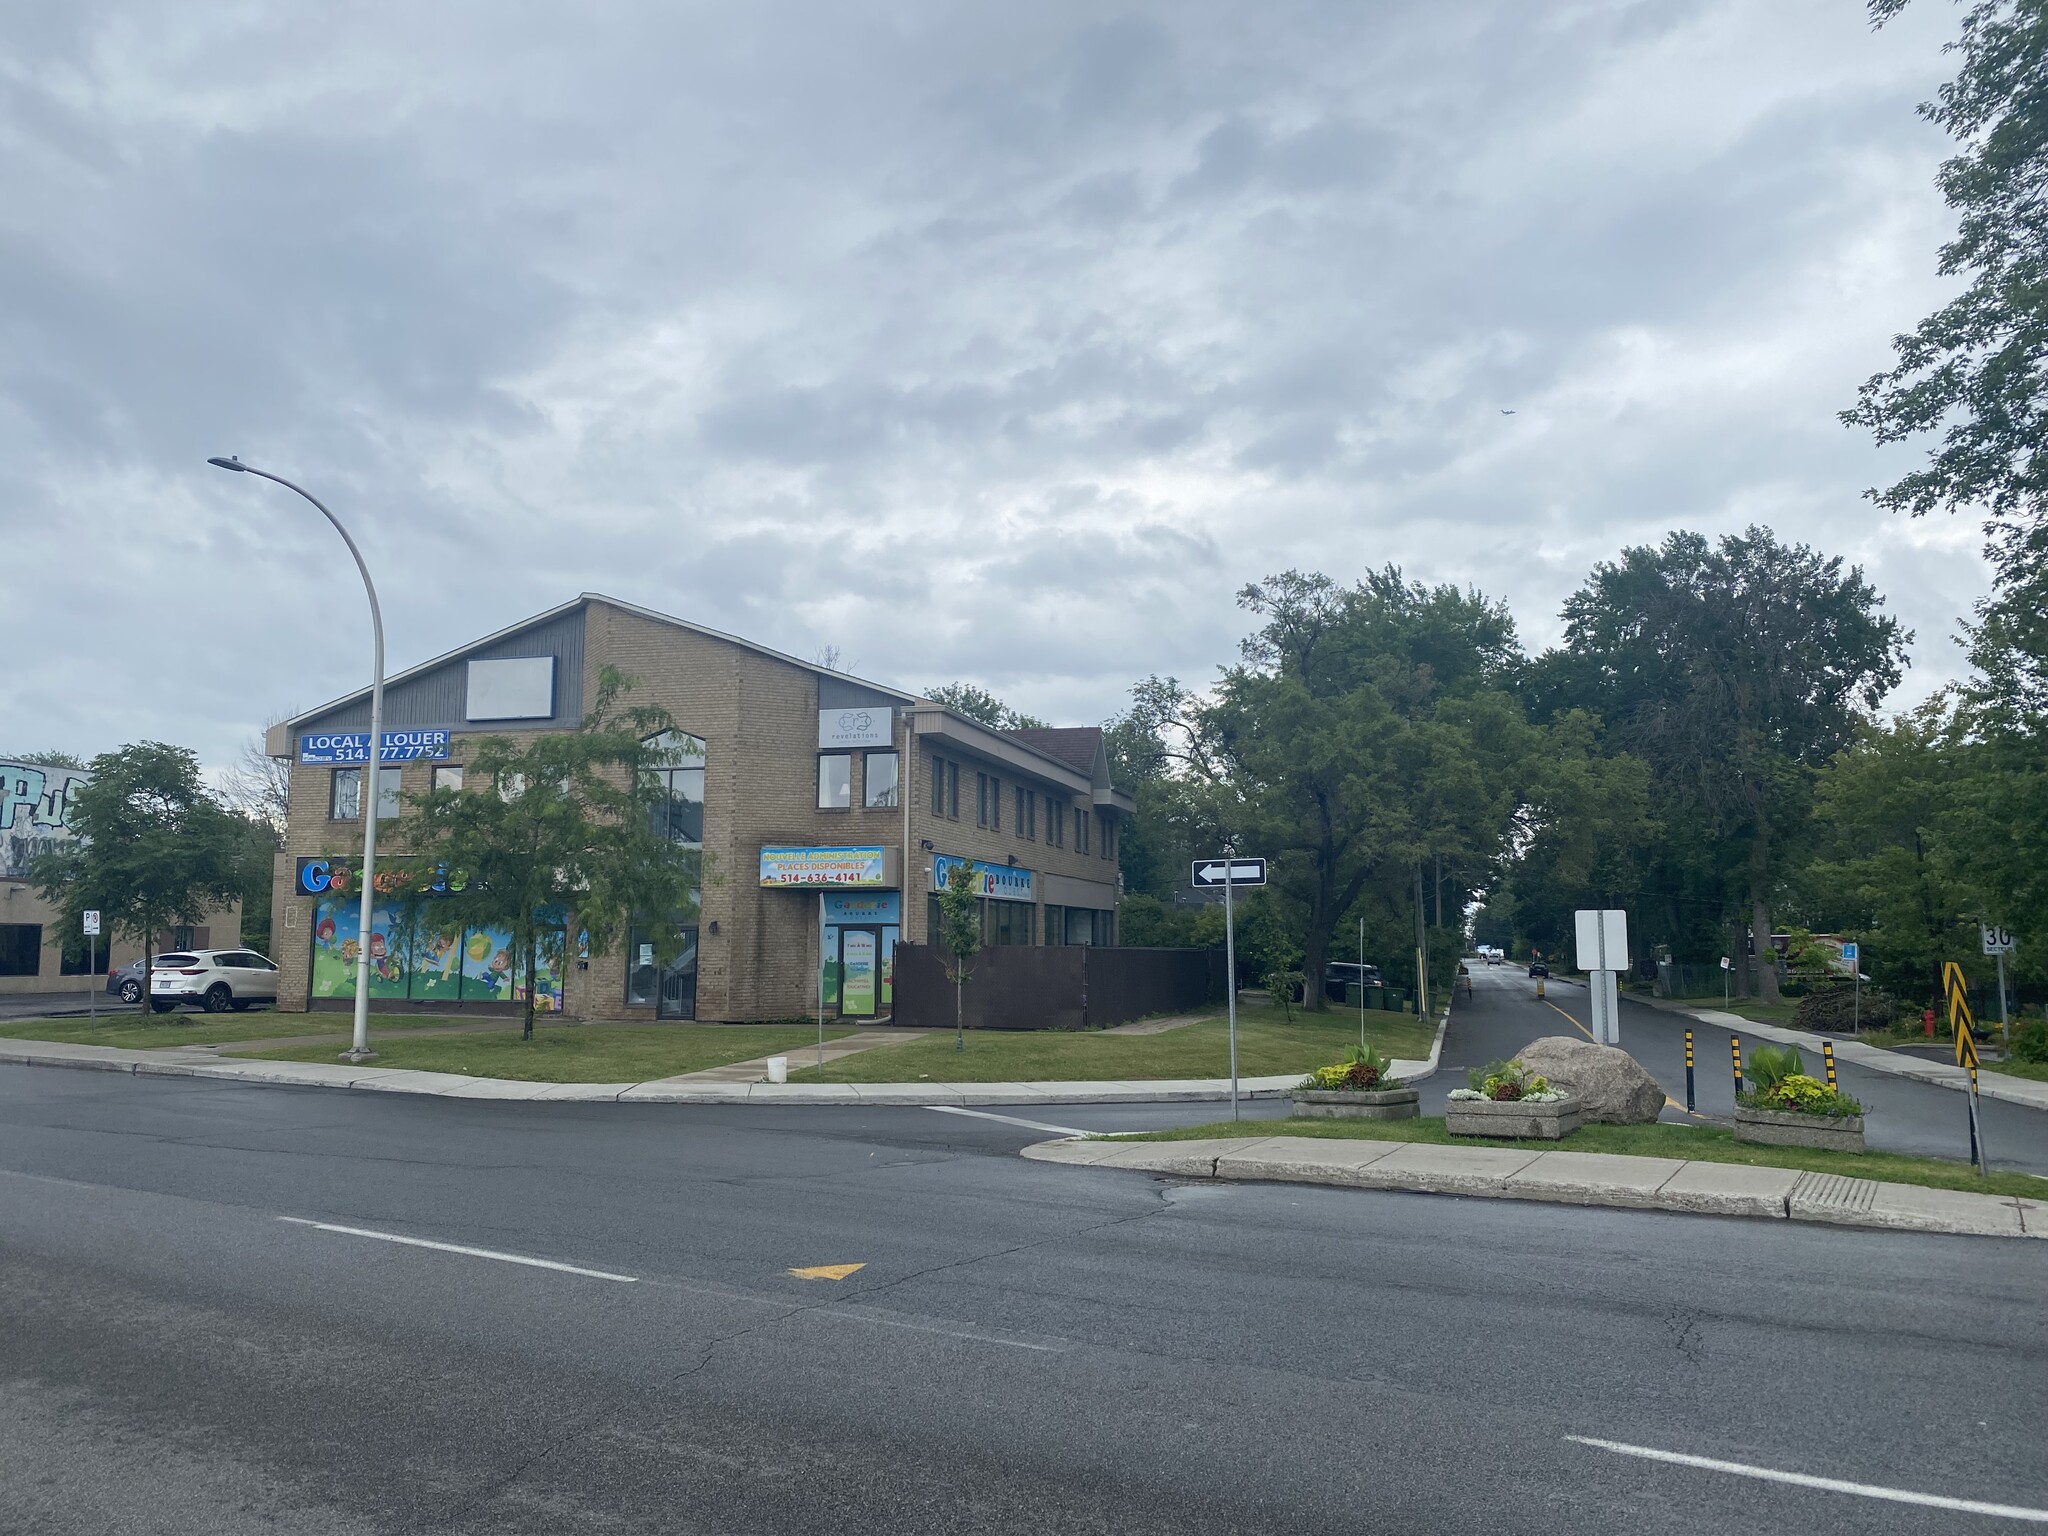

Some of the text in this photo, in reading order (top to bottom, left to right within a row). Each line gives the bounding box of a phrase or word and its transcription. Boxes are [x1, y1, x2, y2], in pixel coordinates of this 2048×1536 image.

[308, 732, 446, 749] LOCAL LOUER
[831, 732, 879, 740] revelations
[335, 745, 445, 761] 514.77.7752
[763, 851, 880, 861] NOUVELLE ADMINISTRATION
[777, 862, 865, 871] PLACES DISPONIBLES
[780, 872, 861, 883] 514-636-4141
[995, 873, 1031, 889] BOURKE
[1986, 928, 2011, 946] 30
